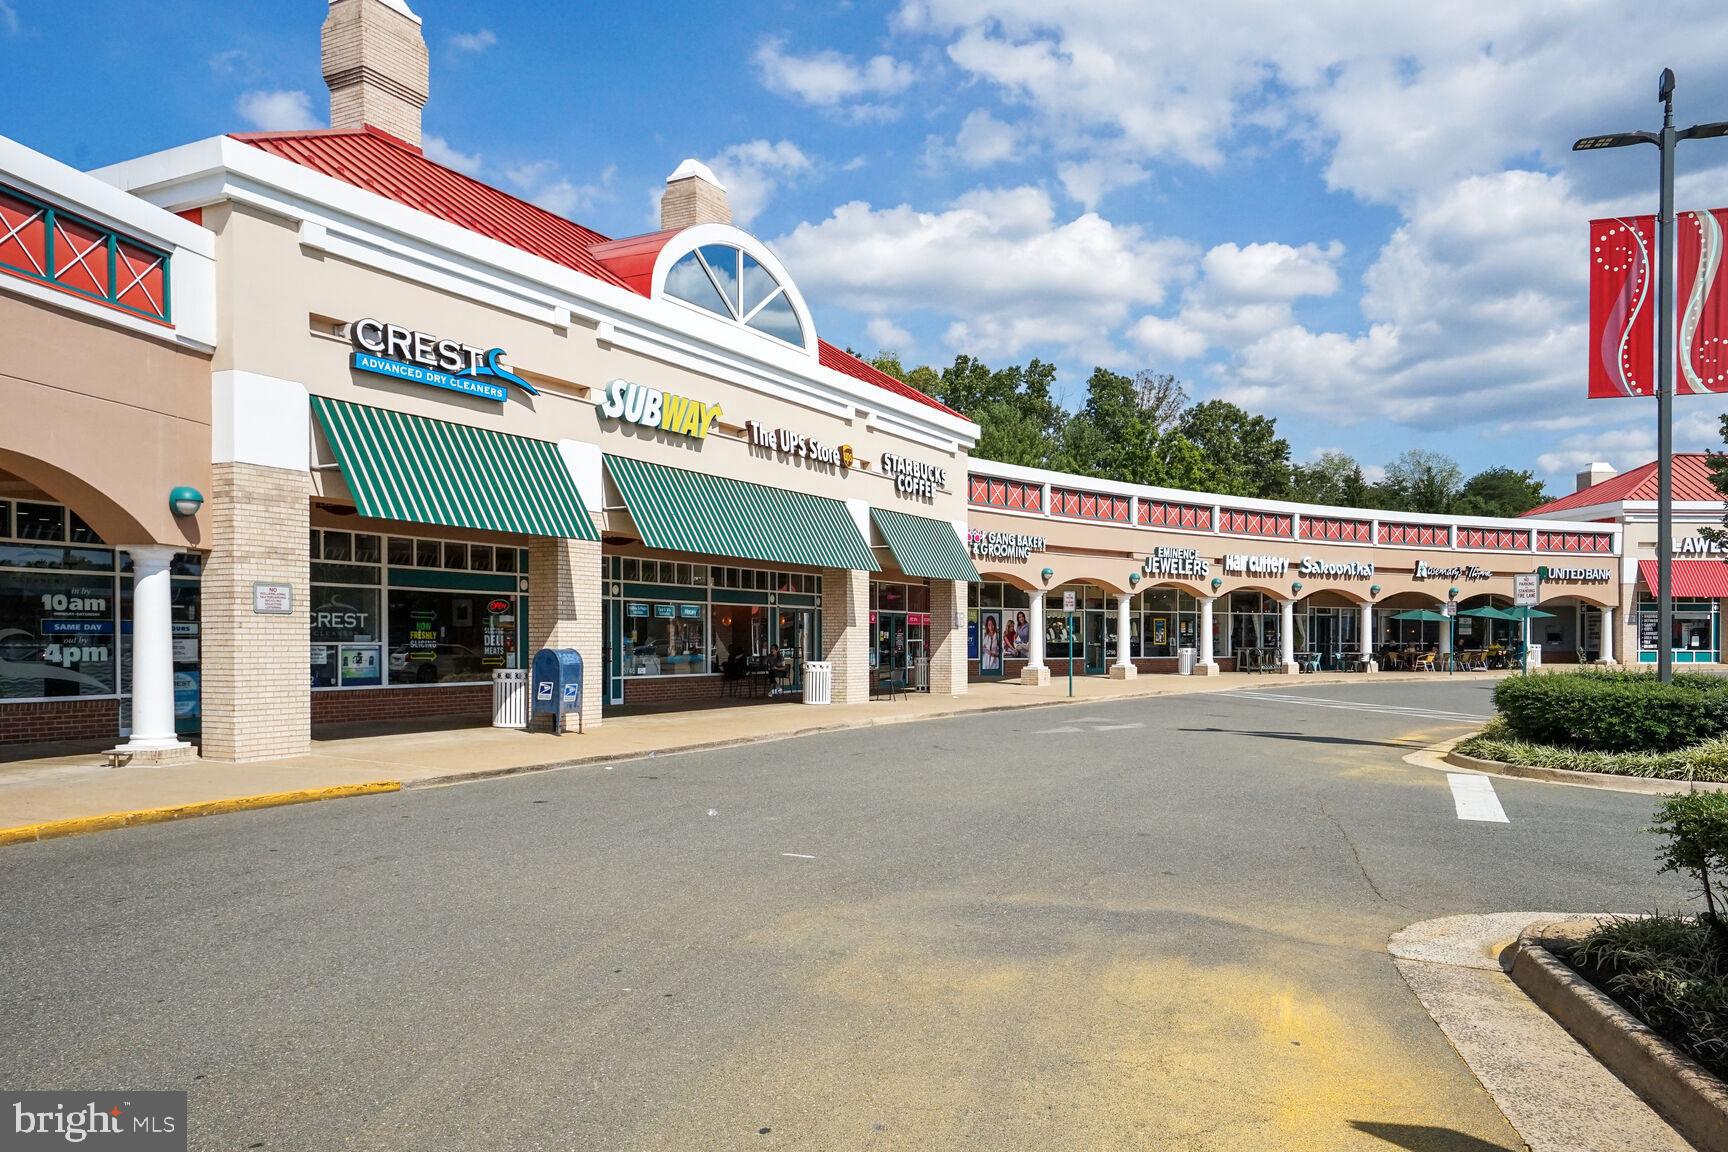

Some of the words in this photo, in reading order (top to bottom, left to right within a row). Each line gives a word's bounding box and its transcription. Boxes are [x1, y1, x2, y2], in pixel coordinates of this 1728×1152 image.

[355, 318, 484, 376] CREST
[361, 357, 423, 378] ADVANCED
[426, 369, 447, 385] DRY
[450, 374, 503, 397] CLEANERS
[600, 378, 723, 439] SUBWAY
[751, 420, 777, 450] The
[780, 429, 807, 457] UPS
[809, 438, 841, 466] Store
[883, 452, 947, 484] STARBUCKS
[897, 475, 938, 498] COFFEE
[988, 532, 1016, 546] GANG
[1017, 534, 1047, 549] BAKERY
[973, 543, 980, 554] &
[981, 544, 1031, 558] GROOMING
[1158, 547, 1200, 560] EMINENCE
[1145, 557, 1210, 576] JEWELERS
[1548, 568, 1585, 579] UNITED
[1585, 569, 1611, 580] BANK
[71, 587, 80, 595] in
[82, 587, 91, 596] by
[41, 594, 106, 611] 10am
[79, 637, 89, 646] by
[410, 631, 437, 639] FRESHLY
[484, 634, 504, 646] DELI
[43, 644, 108, 667] 4pm
